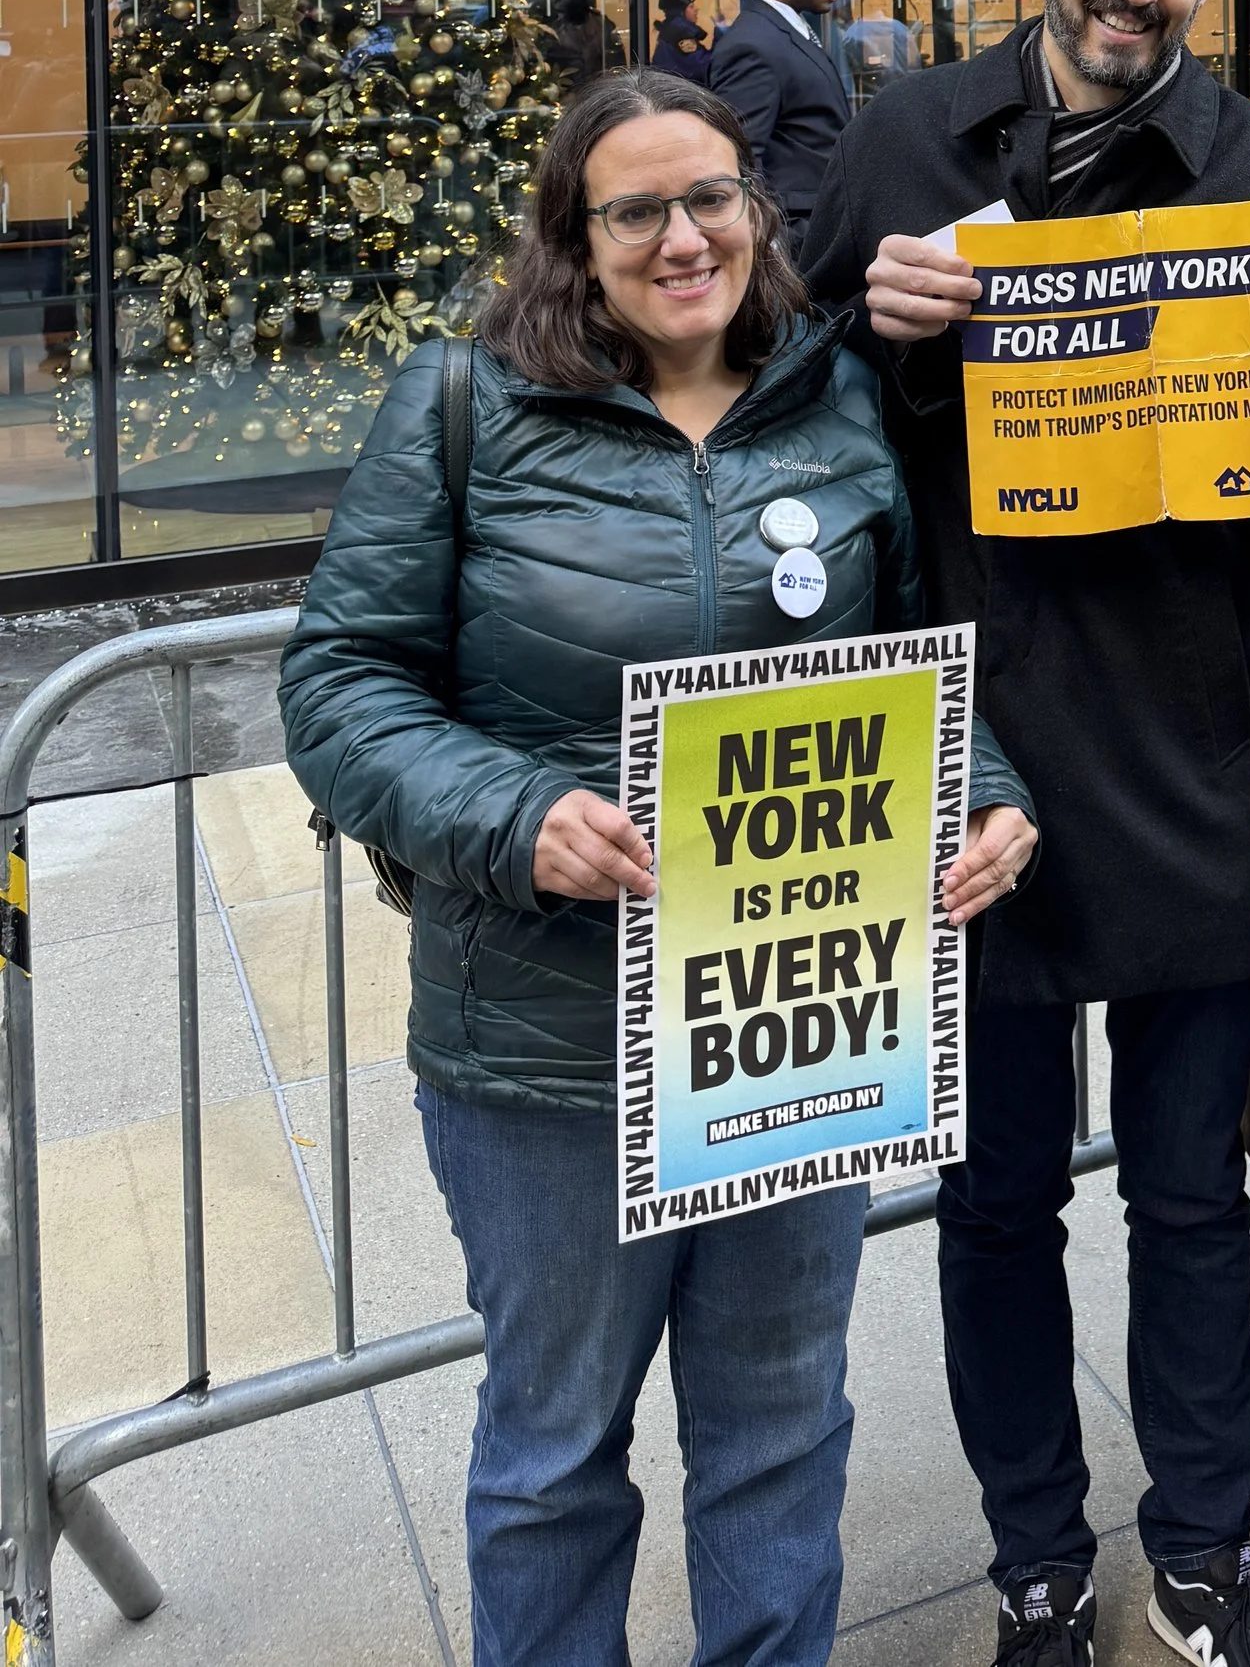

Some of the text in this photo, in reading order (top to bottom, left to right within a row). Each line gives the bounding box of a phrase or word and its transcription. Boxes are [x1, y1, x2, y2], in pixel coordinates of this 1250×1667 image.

[989, 271, 1076, 306] PASS
[1085, 261, 1154, 300] NEW
[992, 318, 1126, 357] FOR ALL
[992, 387, 1068, 410] PROTECT
[1072, 376, 1167, 407] IMMIGRANT
[1172, 371, 1210, 394] NEW
[993, 417, 1041, 439] FROM
[1045, 411, 1123, 438] TRUMP'S
[1127, 398, 1239, 429] DEPORTATION
[780, 459, 831, 474] Columbia
[998, 486, 1079, 513] NYCLU
[631, 632, 967, 701] NY4ALLNY4ALLNY4ALL
[718, 713, 886, 798] NEW
[702, 779, 895, 867] YORK
[733, 869, 860, 924] IS FOR
[684, 917, 907, 1022] EVERY
[690, 987, 899, 1093] BODY!
[709, 1085, 882, 1142] MAKE THE ROAD NY
[625, 1131, 959, 1236] NY4ALLNY4ALLNY4ALL
